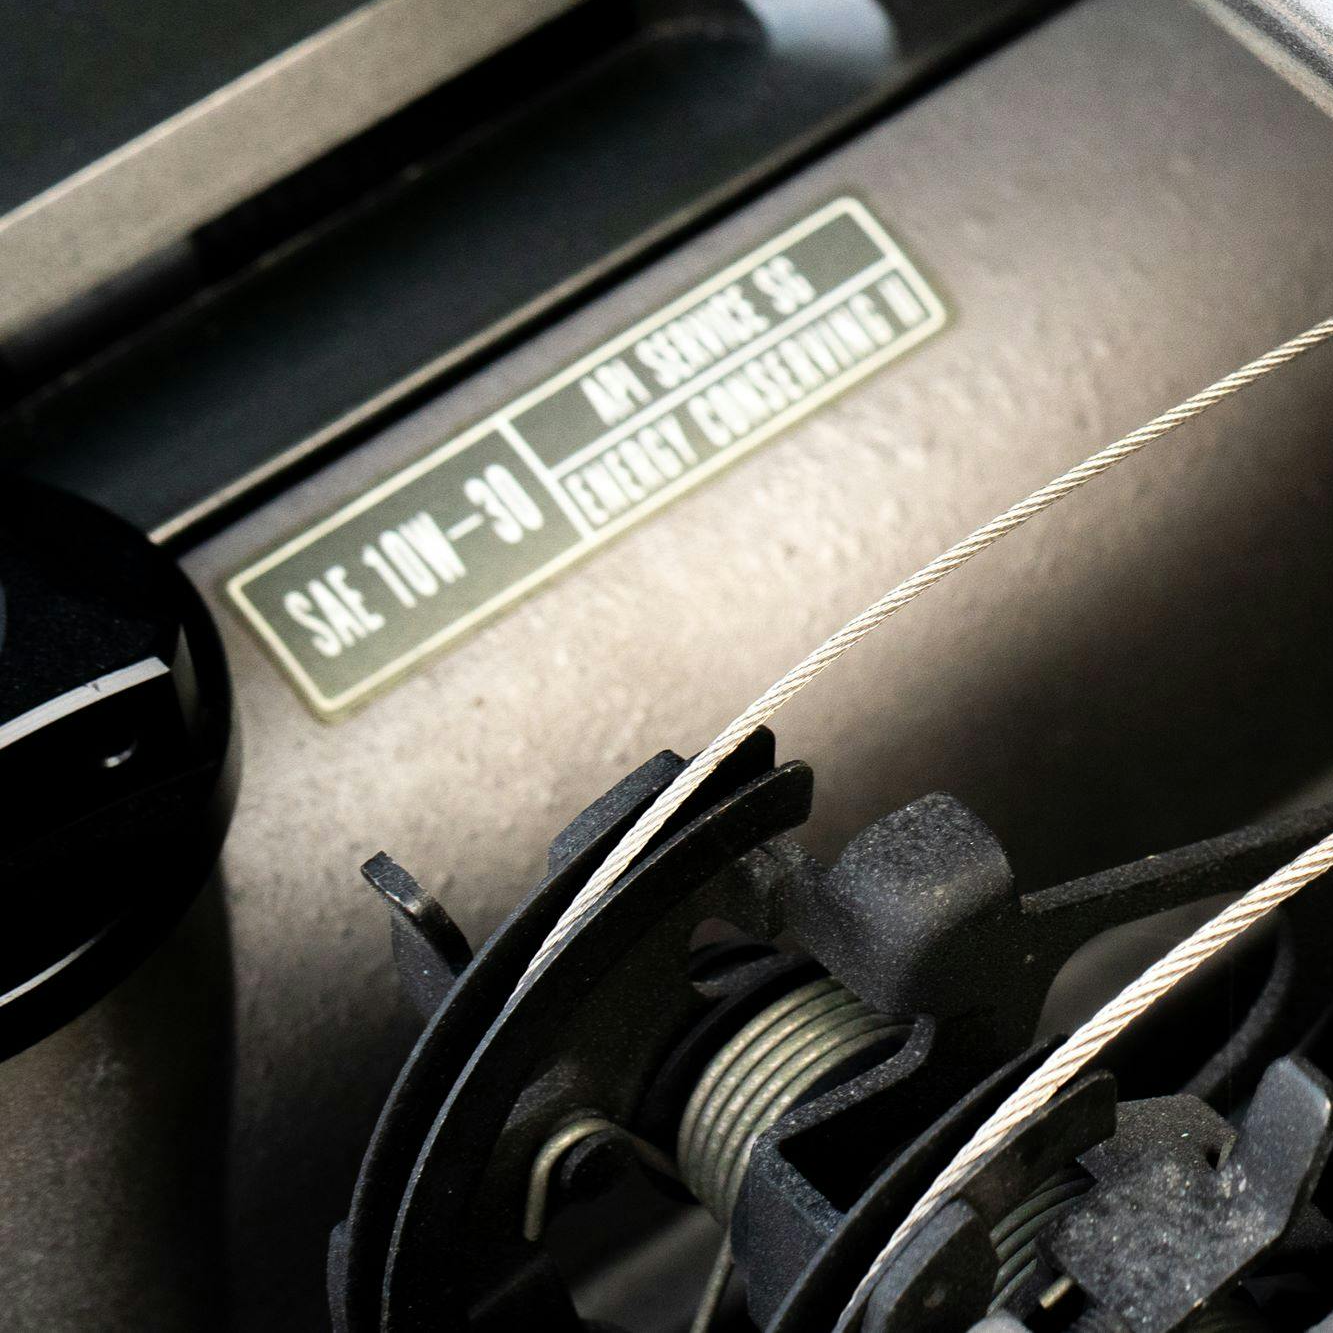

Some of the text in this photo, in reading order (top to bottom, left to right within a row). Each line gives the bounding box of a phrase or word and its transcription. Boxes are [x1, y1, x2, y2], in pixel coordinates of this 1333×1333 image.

[566, 414, 699, 525] ENERGY
[686, 292, 895, 449] CONSERVING
[579, 360, 651, 427] API
[634, 283, 771, 390] SERVICE
[282, 462, 546, 659] SAE 10W-30
